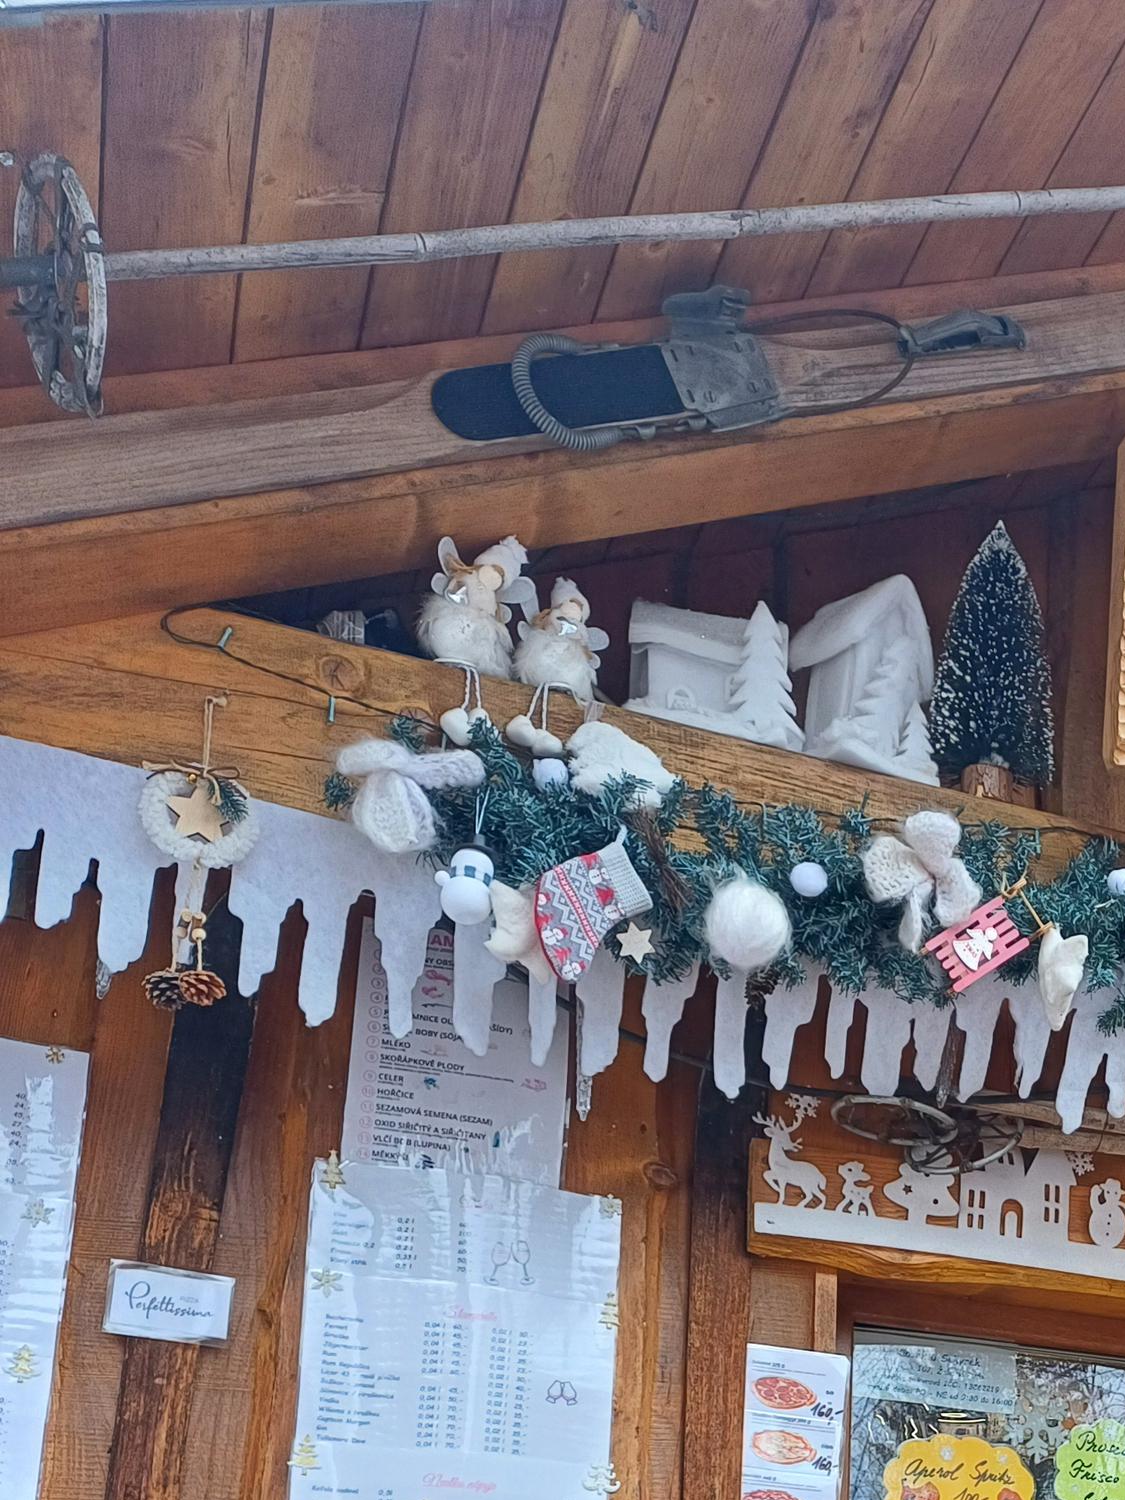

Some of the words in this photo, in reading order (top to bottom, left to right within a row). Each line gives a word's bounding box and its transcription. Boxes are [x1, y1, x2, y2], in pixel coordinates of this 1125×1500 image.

[415, 1029, 438, 1038] BOBY
[440, 1030, 465, 1043] (SÓJA
[380, 1052, 435, 1070] SKOŘÁPKOVÉ
[436, 1059, 465, 1072] PLODY
[378, 1072, 404, 1083] CELER
[376, 1087, 415, 1100] HOŘČICE
[375, 1102, 422, 1117] SEZAMOVÁ
[423, 1109, 459, 1122] SEMENA
[459, 1114, 494, 1127] (SEZAM)
[374, 1119, 397, 1128] OXID
[432, 1126, 439, 1134] A
[904, 1458, 964, 1484] Aperol
[1068, 1458, 1120, 1484] Frisco
